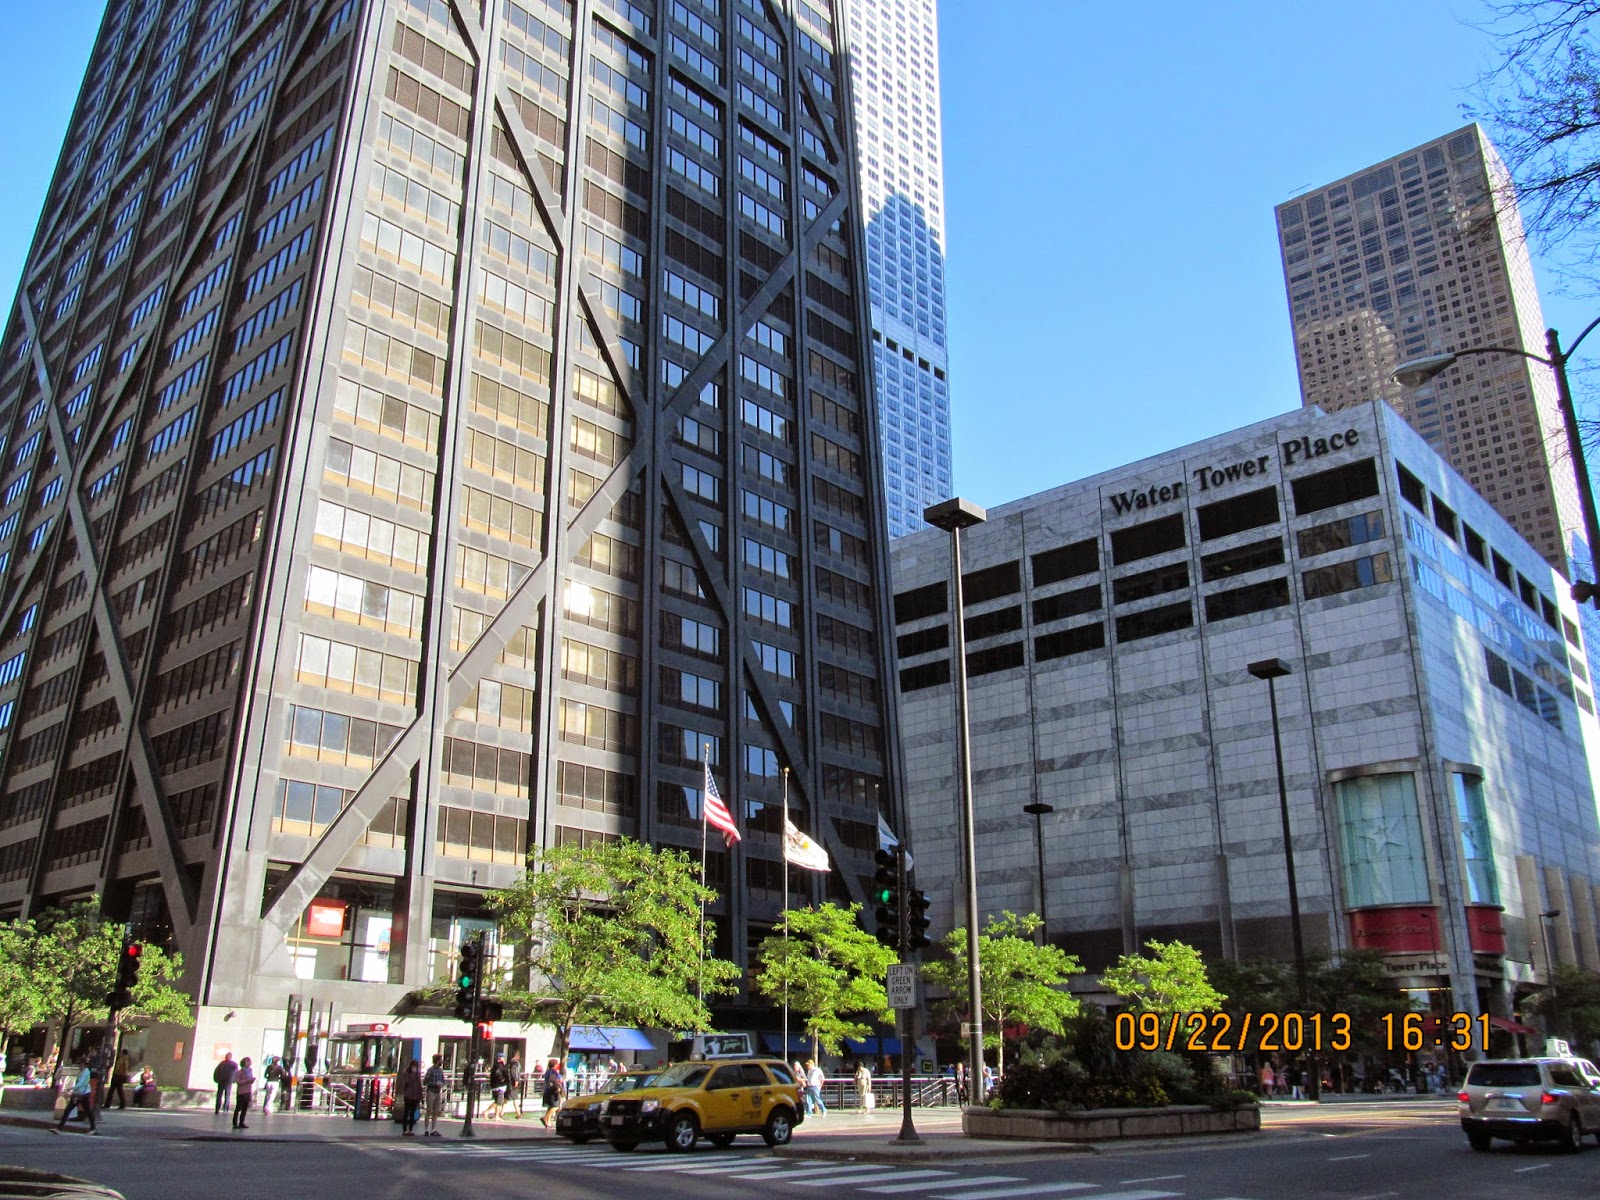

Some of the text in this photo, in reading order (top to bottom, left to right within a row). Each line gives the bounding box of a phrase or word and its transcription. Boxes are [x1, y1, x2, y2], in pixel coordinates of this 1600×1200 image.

[1109, 428, 1360, 515] Water Tower Place
[889, 966, 913, 975] LEFT ON
[1386, 961, 1447, 972] Tower Place
[892, 976, 911, 985] GREEN
[891, 986, 912, 994] ARROW
[894, 995, 909, 1004] ONLY
